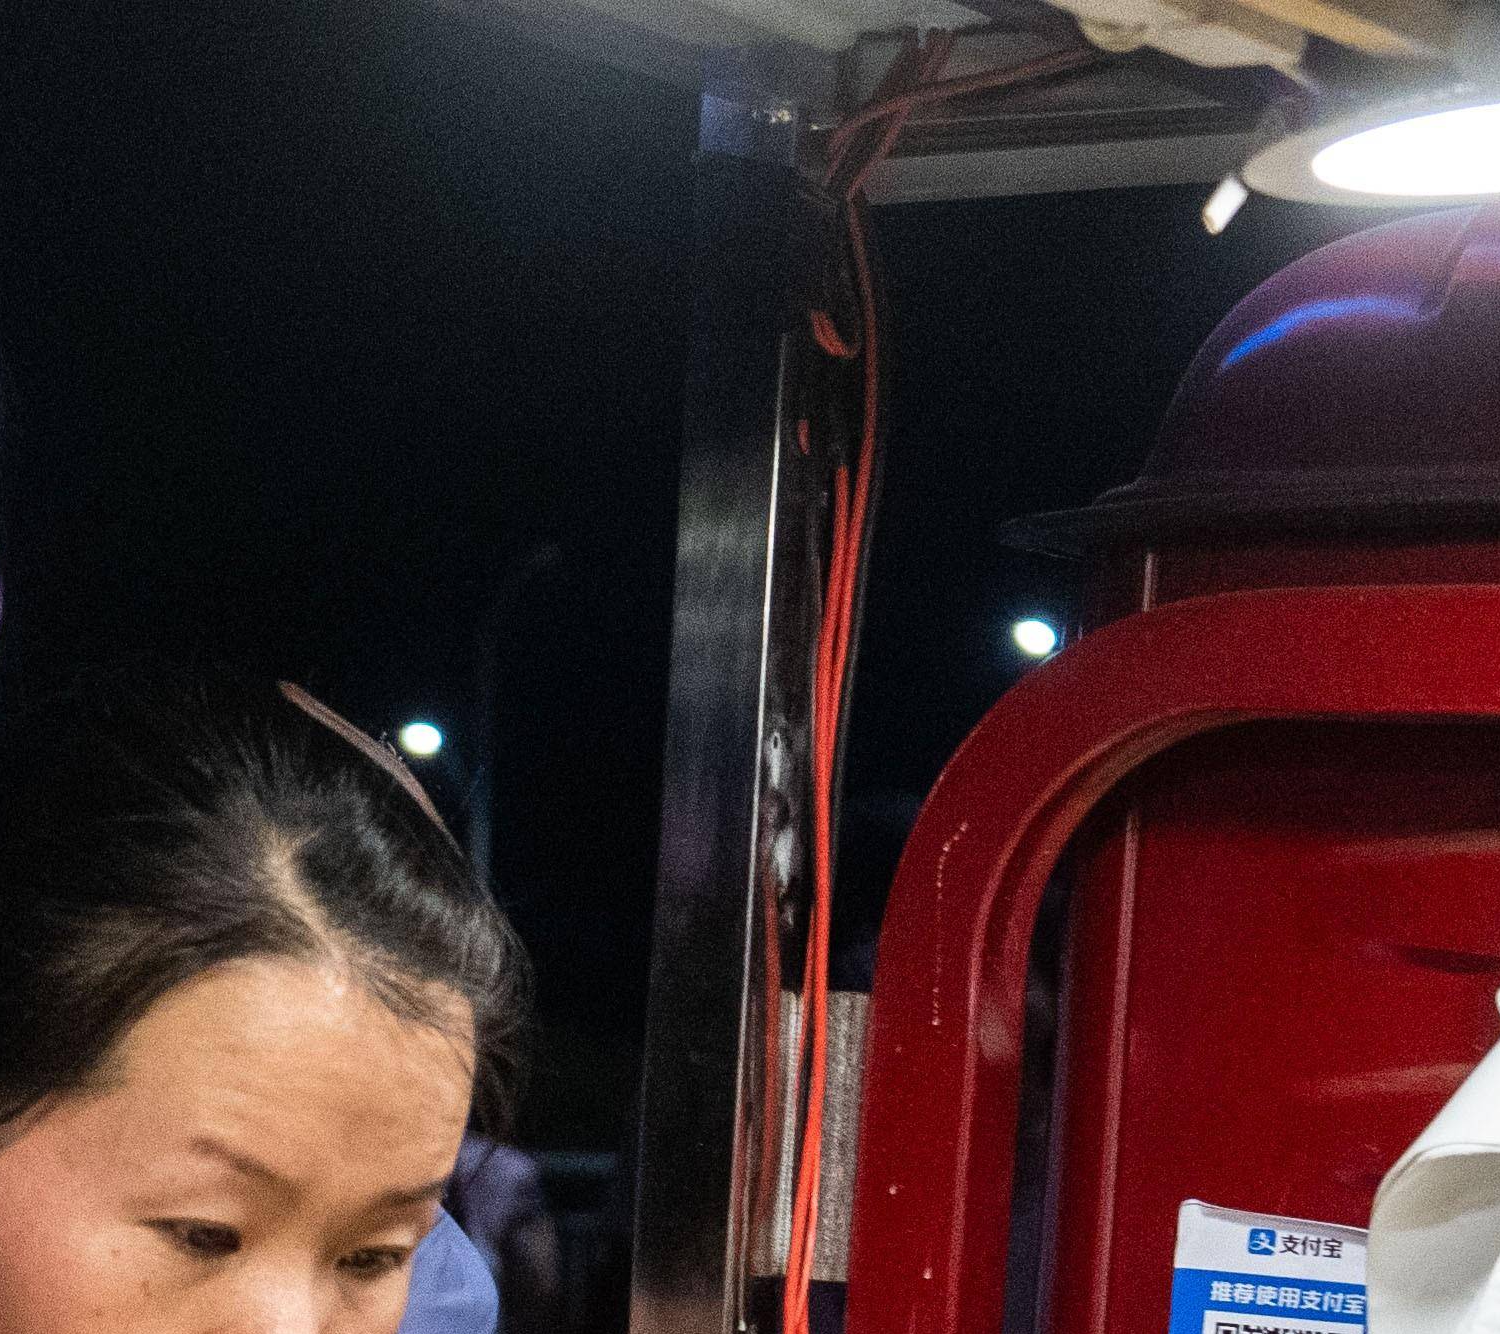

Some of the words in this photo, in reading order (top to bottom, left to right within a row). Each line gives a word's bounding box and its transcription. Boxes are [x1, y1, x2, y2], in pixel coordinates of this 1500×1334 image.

[1280, 1234, 1343, 1260] 支付宝
[1210, 1280, 1366, 1316] 推荐使用支付宝
